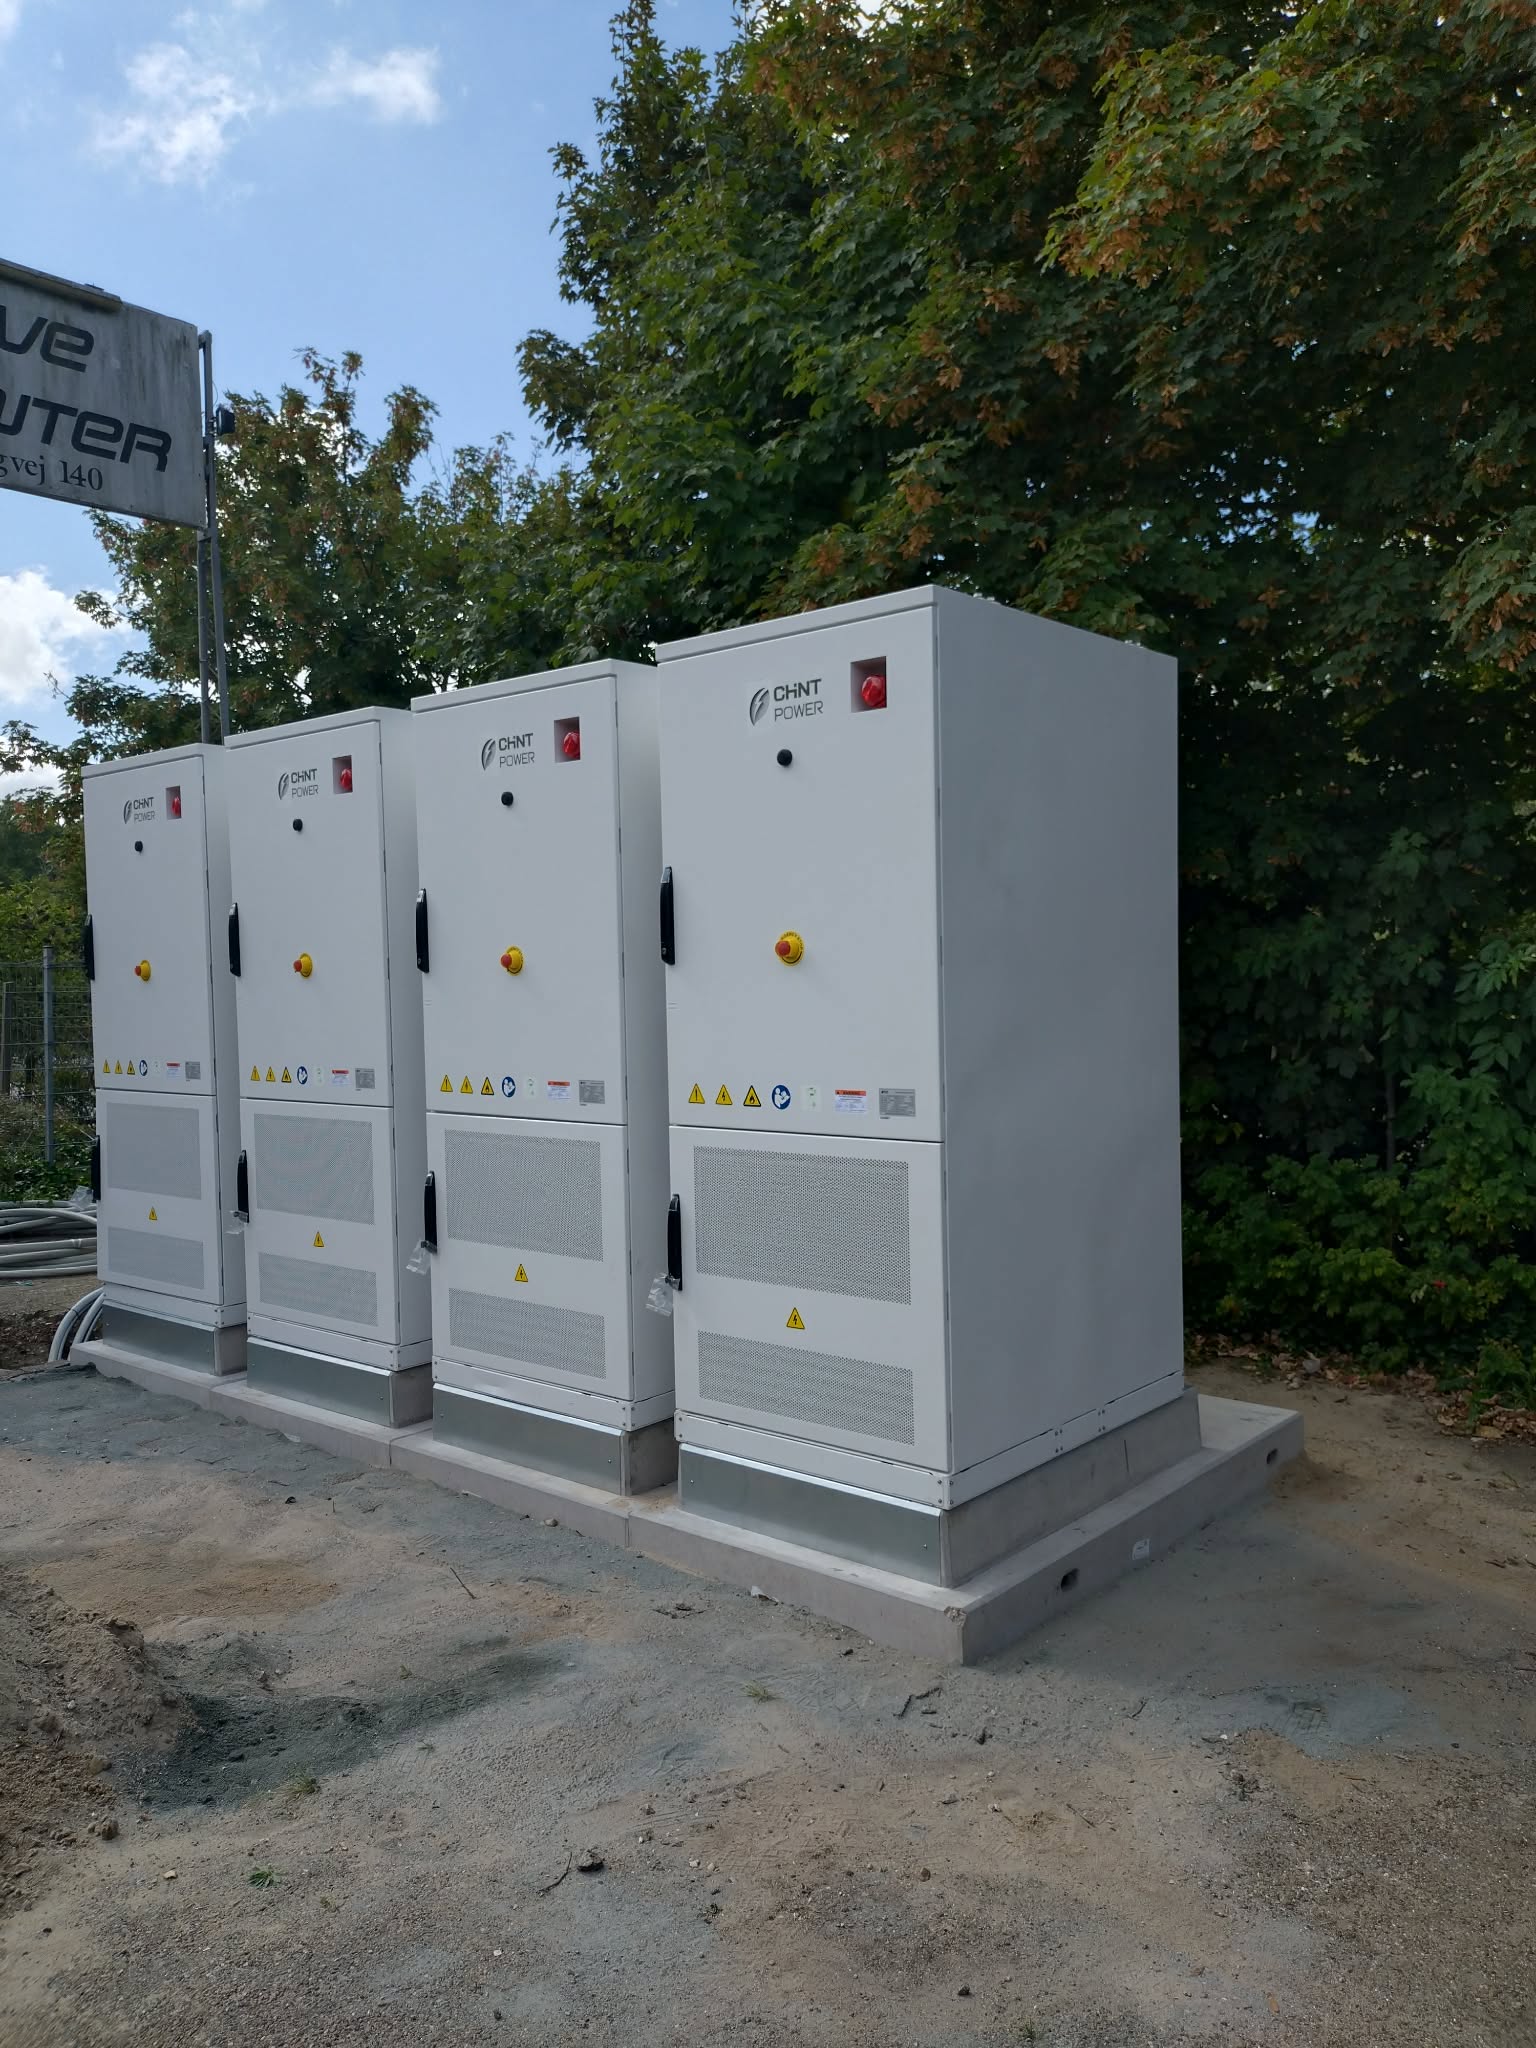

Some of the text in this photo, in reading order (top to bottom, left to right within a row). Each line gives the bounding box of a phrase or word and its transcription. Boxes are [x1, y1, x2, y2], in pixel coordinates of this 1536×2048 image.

[59, 460, 103, 490] 140
[774, 700, 824, 722] POWER
[499, 751, 535, 768] POWER
[291, 785, 319, 798] POWER
